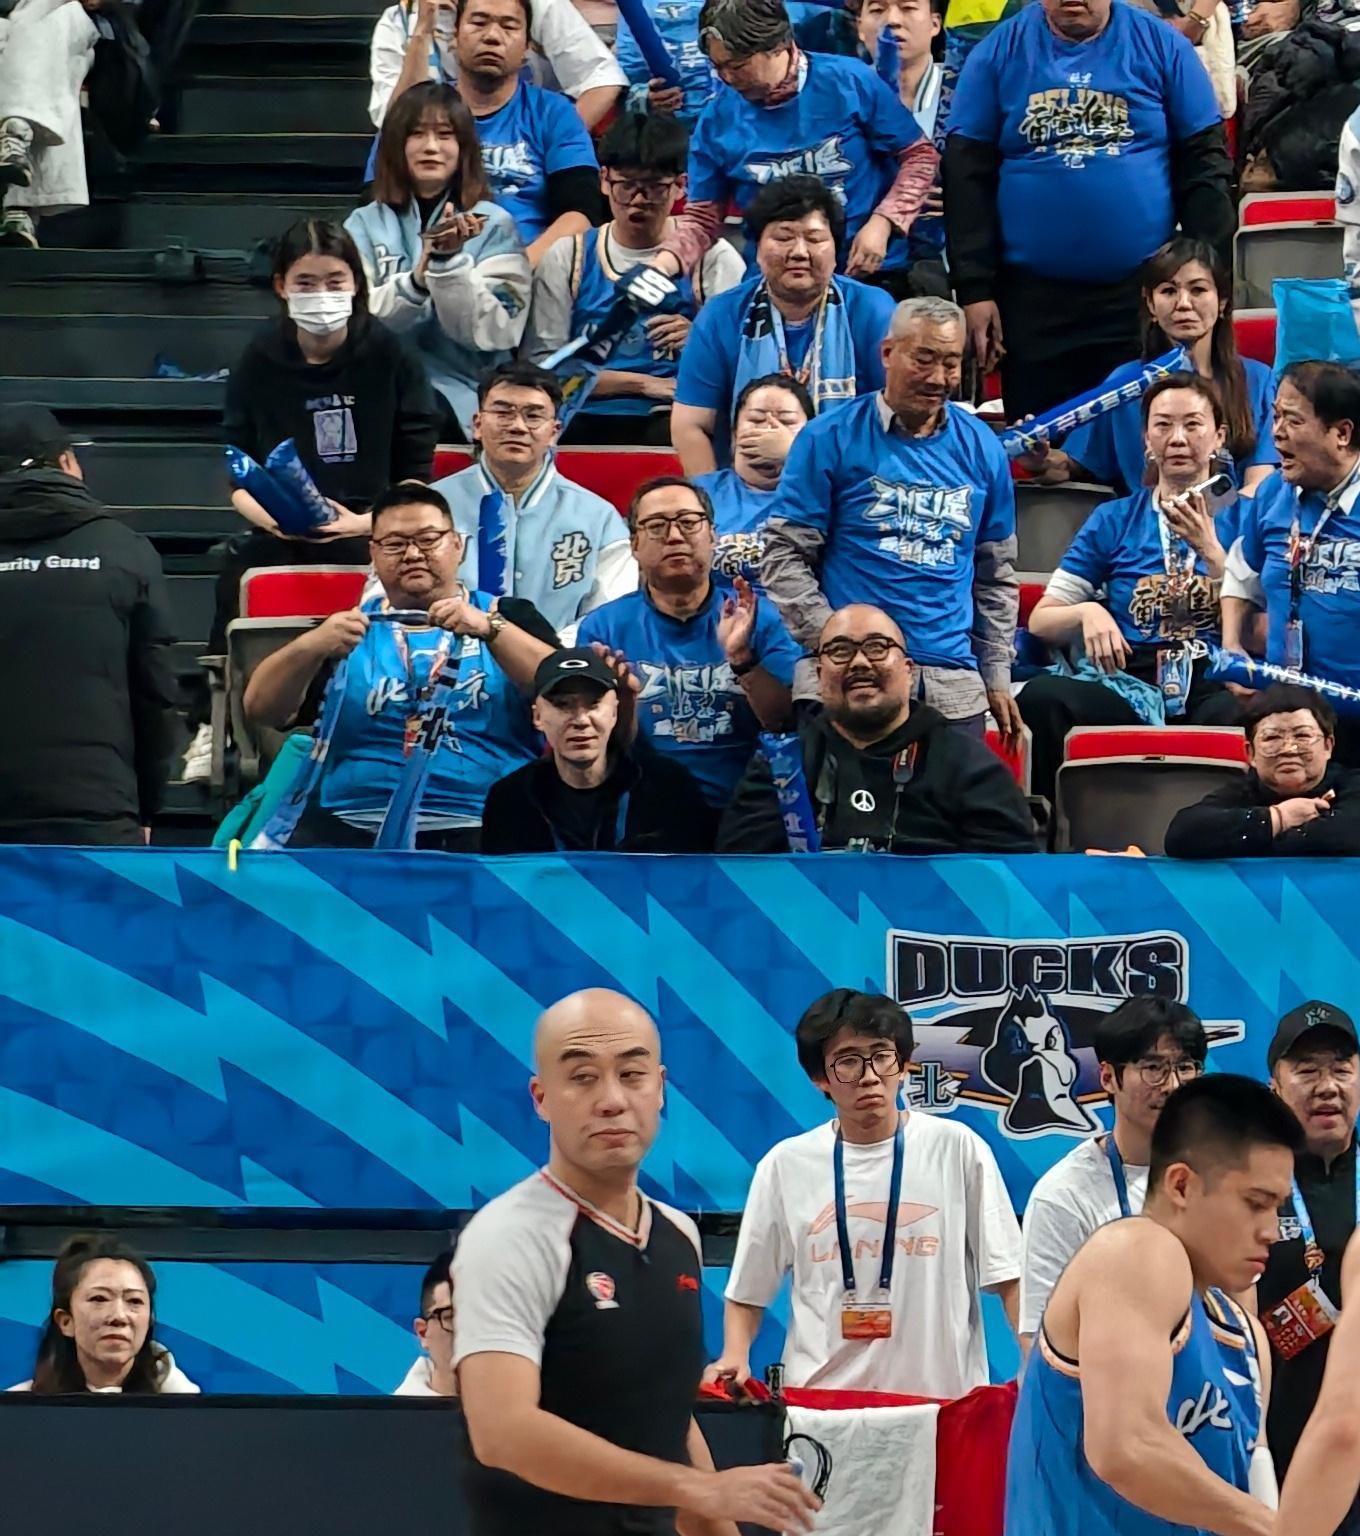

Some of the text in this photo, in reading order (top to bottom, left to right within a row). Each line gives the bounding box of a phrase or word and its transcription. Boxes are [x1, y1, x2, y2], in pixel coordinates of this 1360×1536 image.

[45, 555, 101, 571] Guard
[552, 531, 593, 591] 北京
[899, 938, 1182, 1005] DUCKS
[909, 1061, 955, 1107] 北
